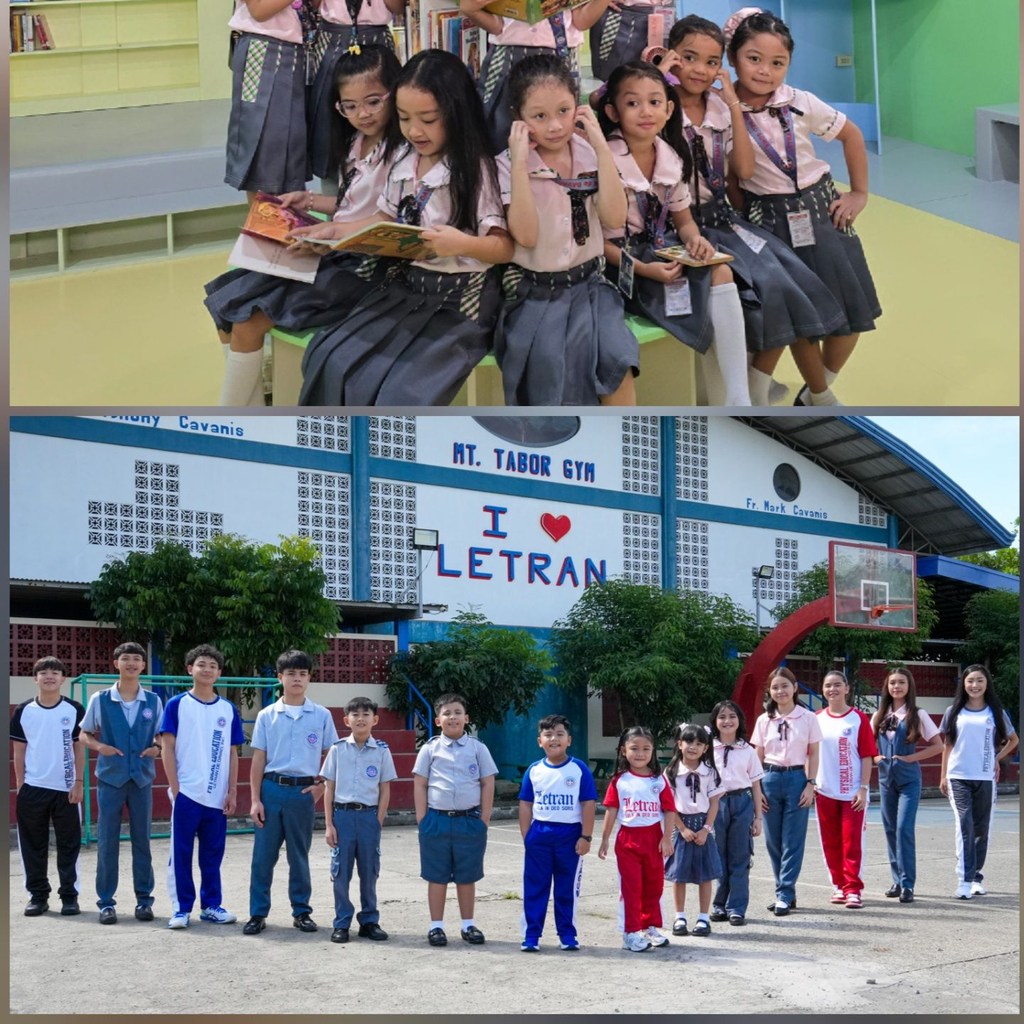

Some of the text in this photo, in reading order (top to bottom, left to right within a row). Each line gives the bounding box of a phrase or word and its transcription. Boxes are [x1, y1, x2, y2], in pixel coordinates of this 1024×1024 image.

[179, 416, 244, 437] Cavanis
[453, 442, 595, 483] MT. TABOR GYM
[482, 504, 508, 540] I
[746, 497, 828, 519] Fr. Mark Cavanis
[437, 543, 607, 589] LETRAN
[839, 737, 849, 794] PHYSICAL EDUCATION
